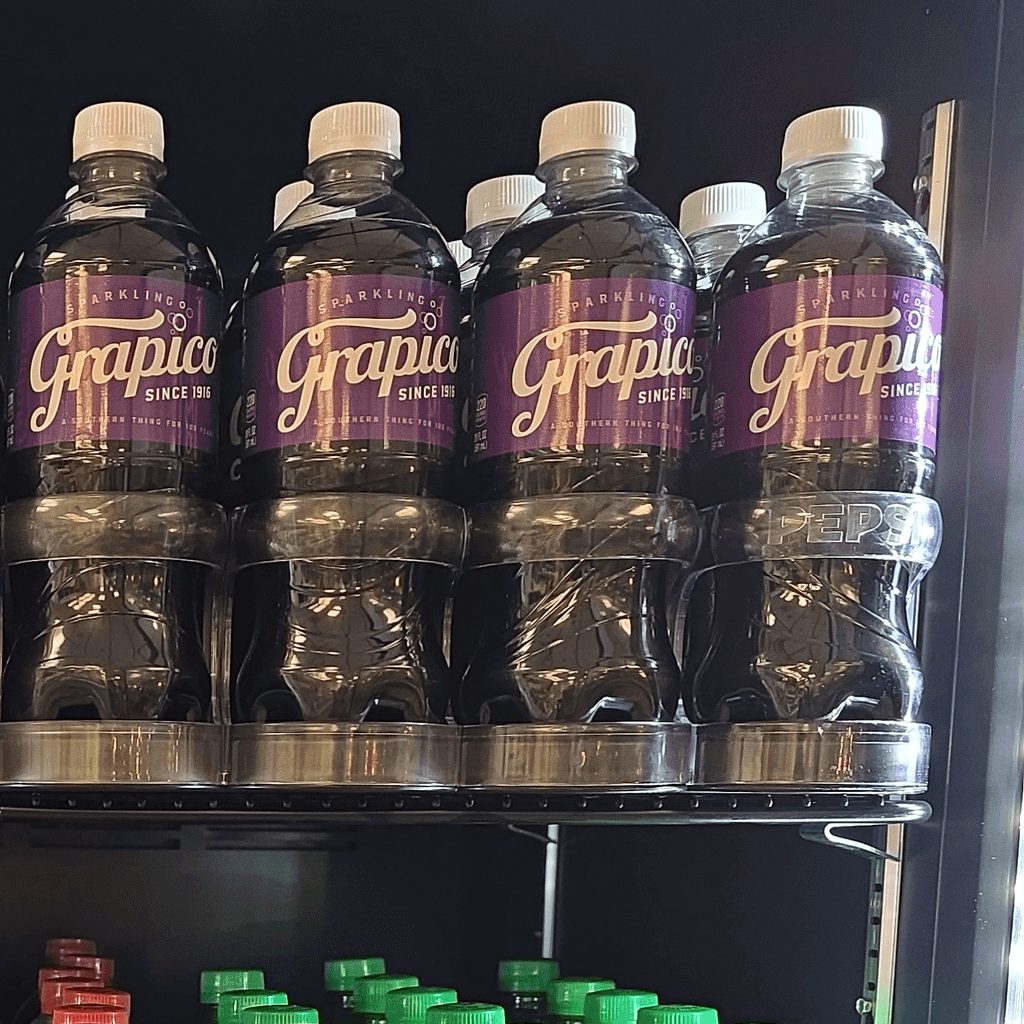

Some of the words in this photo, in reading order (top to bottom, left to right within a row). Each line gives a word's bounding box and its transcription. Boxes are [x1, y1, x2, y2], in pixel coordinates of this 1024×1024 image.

[66, 289, 173, 314] SPARKLING
[318, 289, 425, 315] SPARKLING
[556, 292, 664, 318] SPARKLING
[30, 309, 219, 432] Grapico
[277, 308, 459, 433] Grapico
[145, 385, 188, 401] SINCE
[192, 385, 211, 399] 1916
[398, 385, 437, 400] SINCE
[441, 385, 455, 398] 1916
[638, 388, 675, 404] SINCE
[880, 383, 920, 398] SINCE
[132, 416, 161, 426] THING
[767, 503, 916, 545] PEPS
